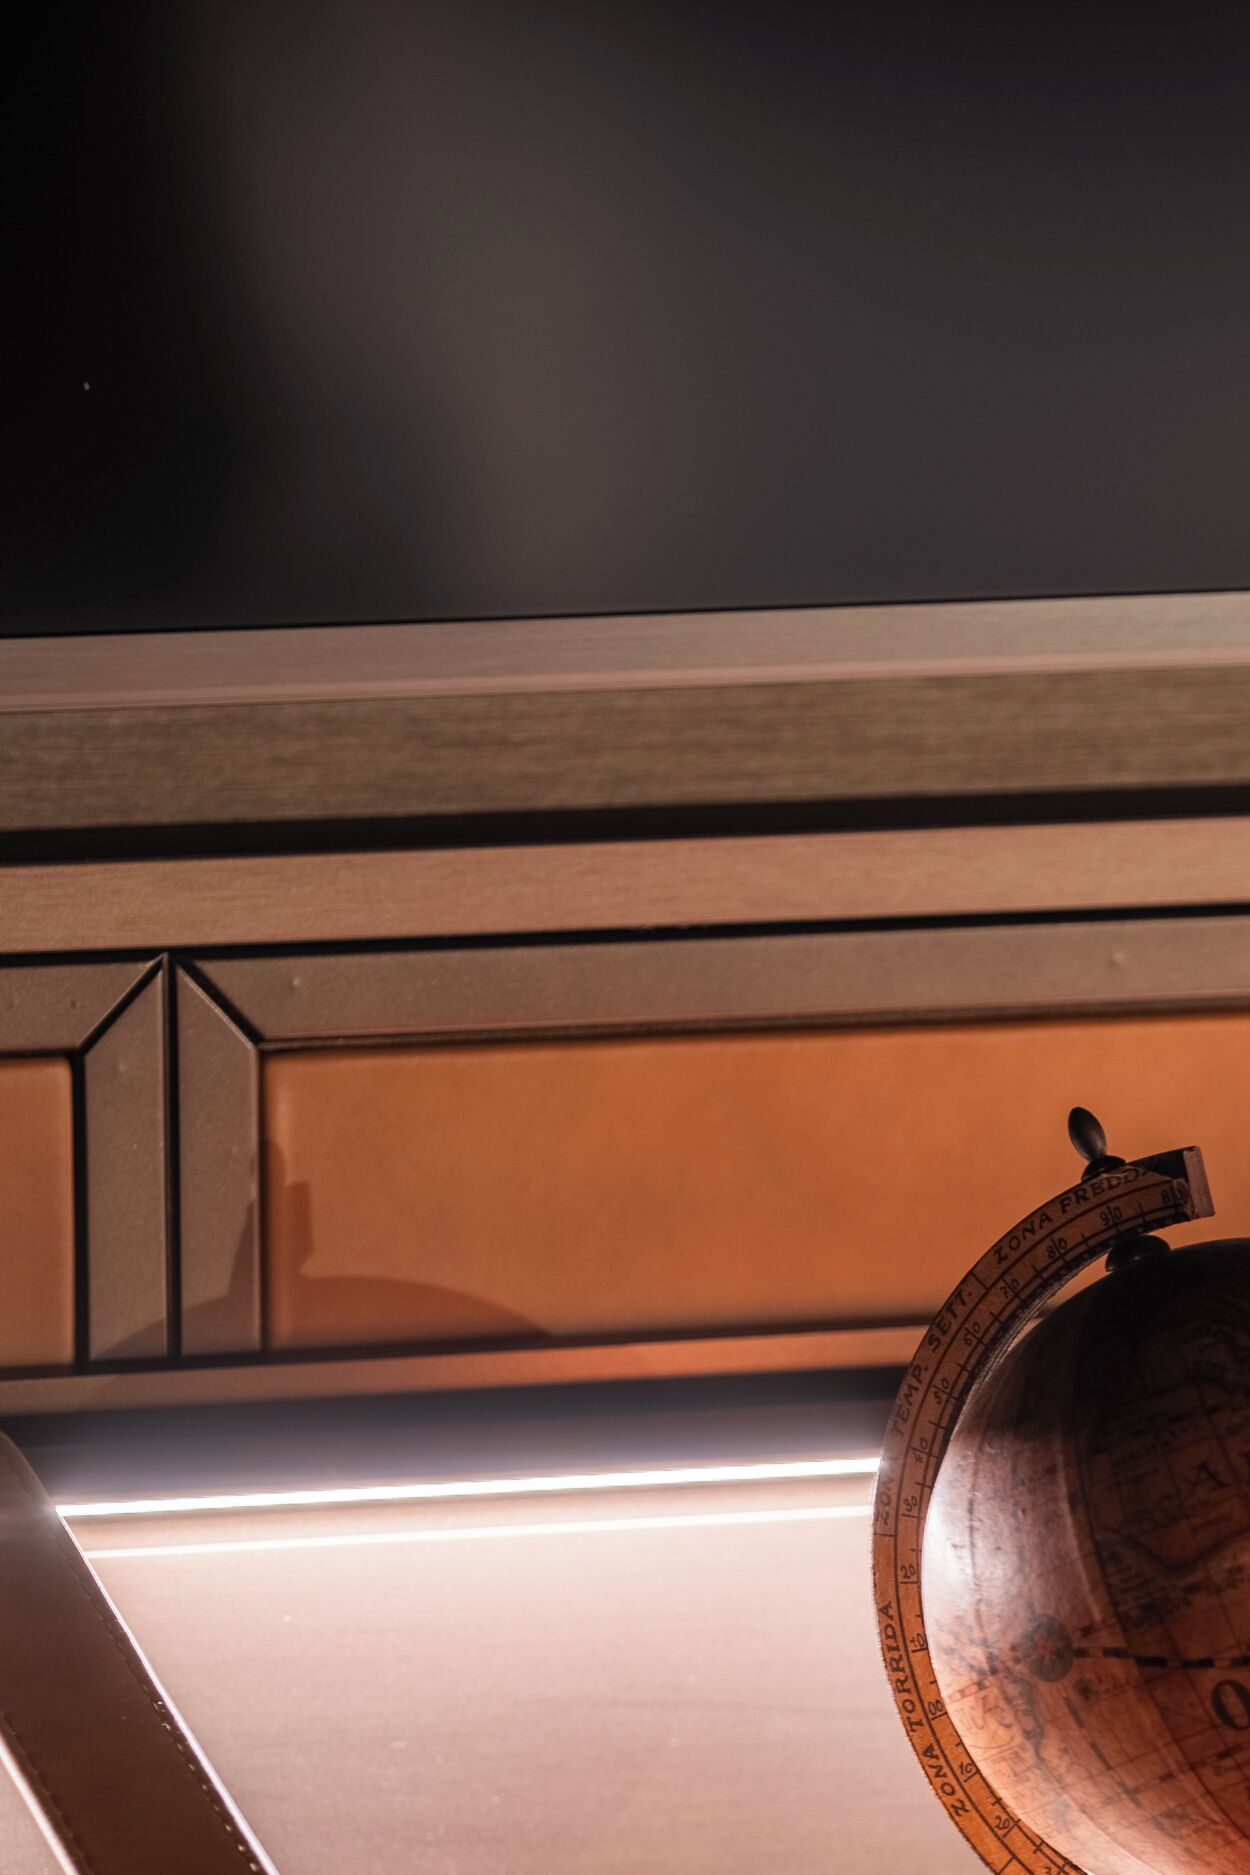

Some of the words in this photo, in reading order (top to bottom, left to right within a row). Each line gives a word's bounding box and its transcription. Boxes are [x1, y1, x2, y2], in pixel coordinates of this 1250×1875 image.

[1100, 1205, 1122, 1225] 90
[993, 1211, 1053, 1264] ZONA
[1046, 1237, 1068, 1259] 80
[1000, 1279, 1020, 1299] 70
[927, 1286, 973, 1353] SETT.
[964, 1321, 981, 1346] 60
[933, 1377, 950, 1405] 50
[903, 1495, 918, 1513] 30
[901, 1564, 916, 1579] 20
[879, 1600, 924, 1733] TORRIDA
[922, 1743, 970, 1818] ZONA
[994, 1815, 1011, 1831] 20
